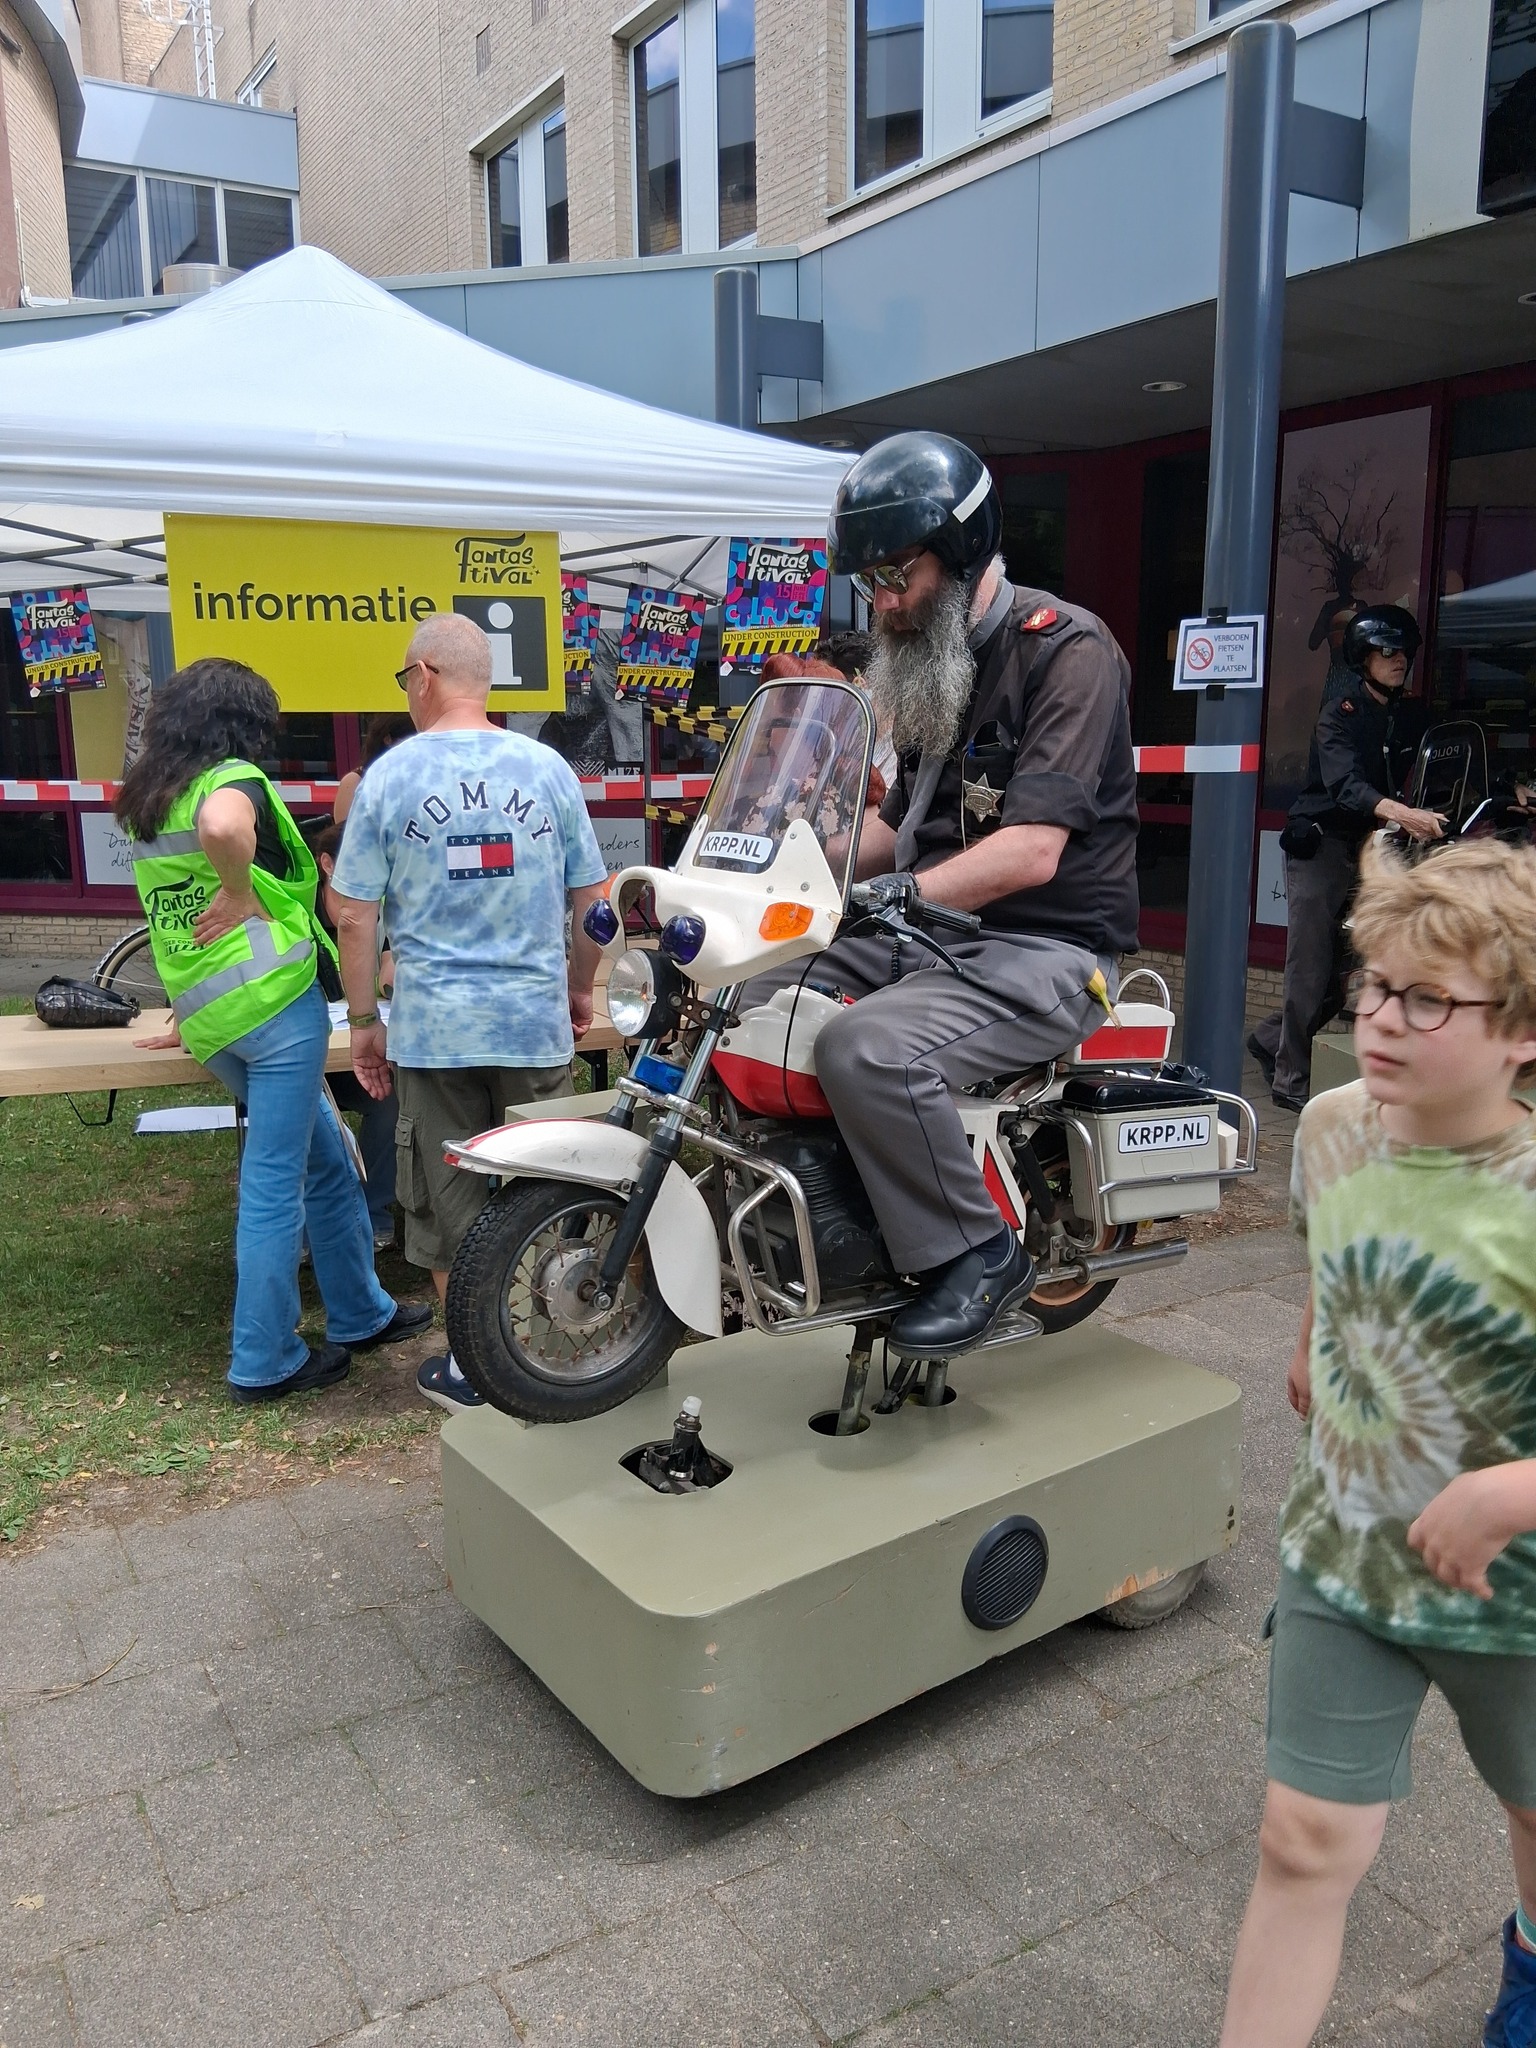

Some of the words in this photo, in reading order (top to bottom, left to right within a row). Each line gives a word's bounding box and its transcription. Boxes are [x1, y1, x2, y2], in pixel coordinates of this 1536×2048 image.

[193, 582, 437, 622] informatie
[724, 634, 752, 642] UNDER
[754, 630, 817, 640] CONSTRUCTION
[26, 664, 50, 674] UNDER
[50, 654, 100, 669] CONSTRUCTION
[618, 667, 642, 675] UNDER
[642, 668, 692, 678] CONSTRUCTION
[404, 781, 553, 844] TOMMY
[450, 835, 510, 845] TOMMY
[703, 836, 761, 858] KRPP.NL
[452, 868, 511, 878] JEANS
[1127, 1122, 1205, 1146] KRPP.NL
